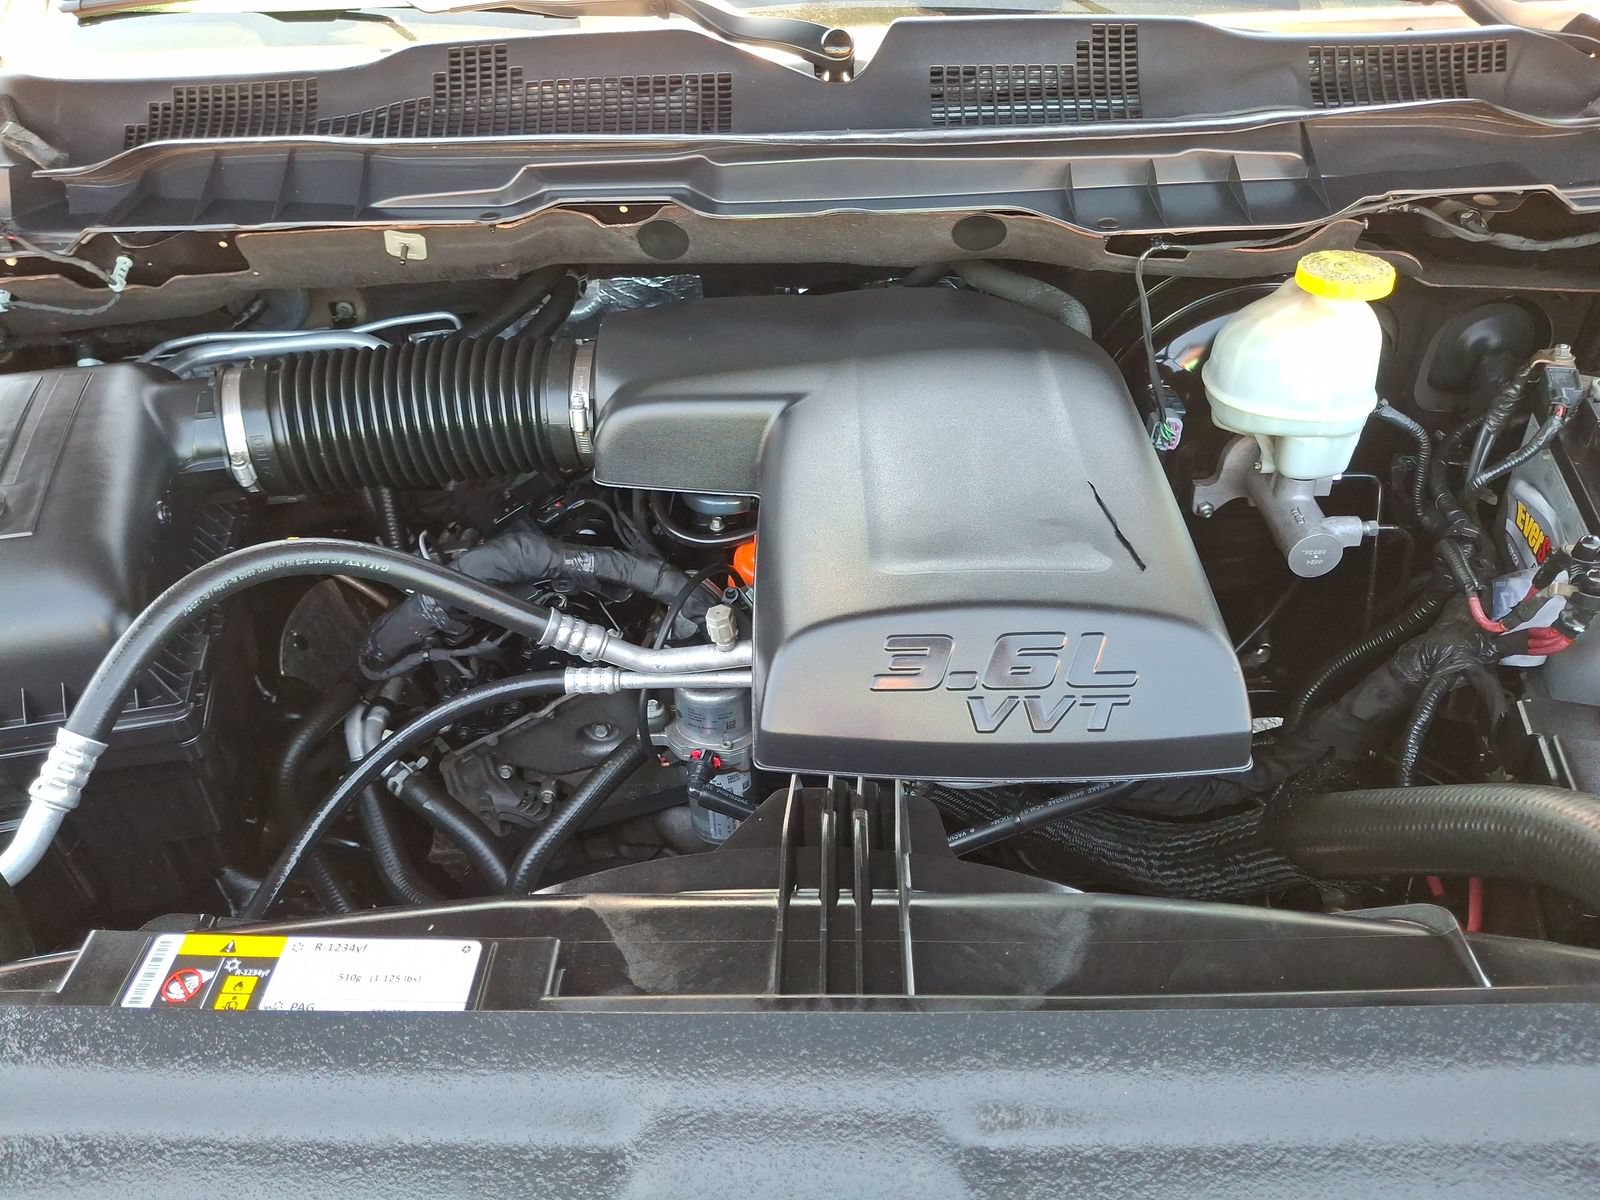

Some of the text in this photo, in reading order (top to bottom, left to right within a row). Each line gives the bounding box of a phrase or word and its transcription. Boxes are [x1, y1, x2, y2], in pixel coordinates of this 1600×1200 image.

[870, 631, 1139, 692] 3.6L
[966, 694, 1131, 734] VVT
[314, 942, 368, 953] R-1234yf
[338, 973, 362, 983] 510g
[290, 1001, 315, 1011] PAG
